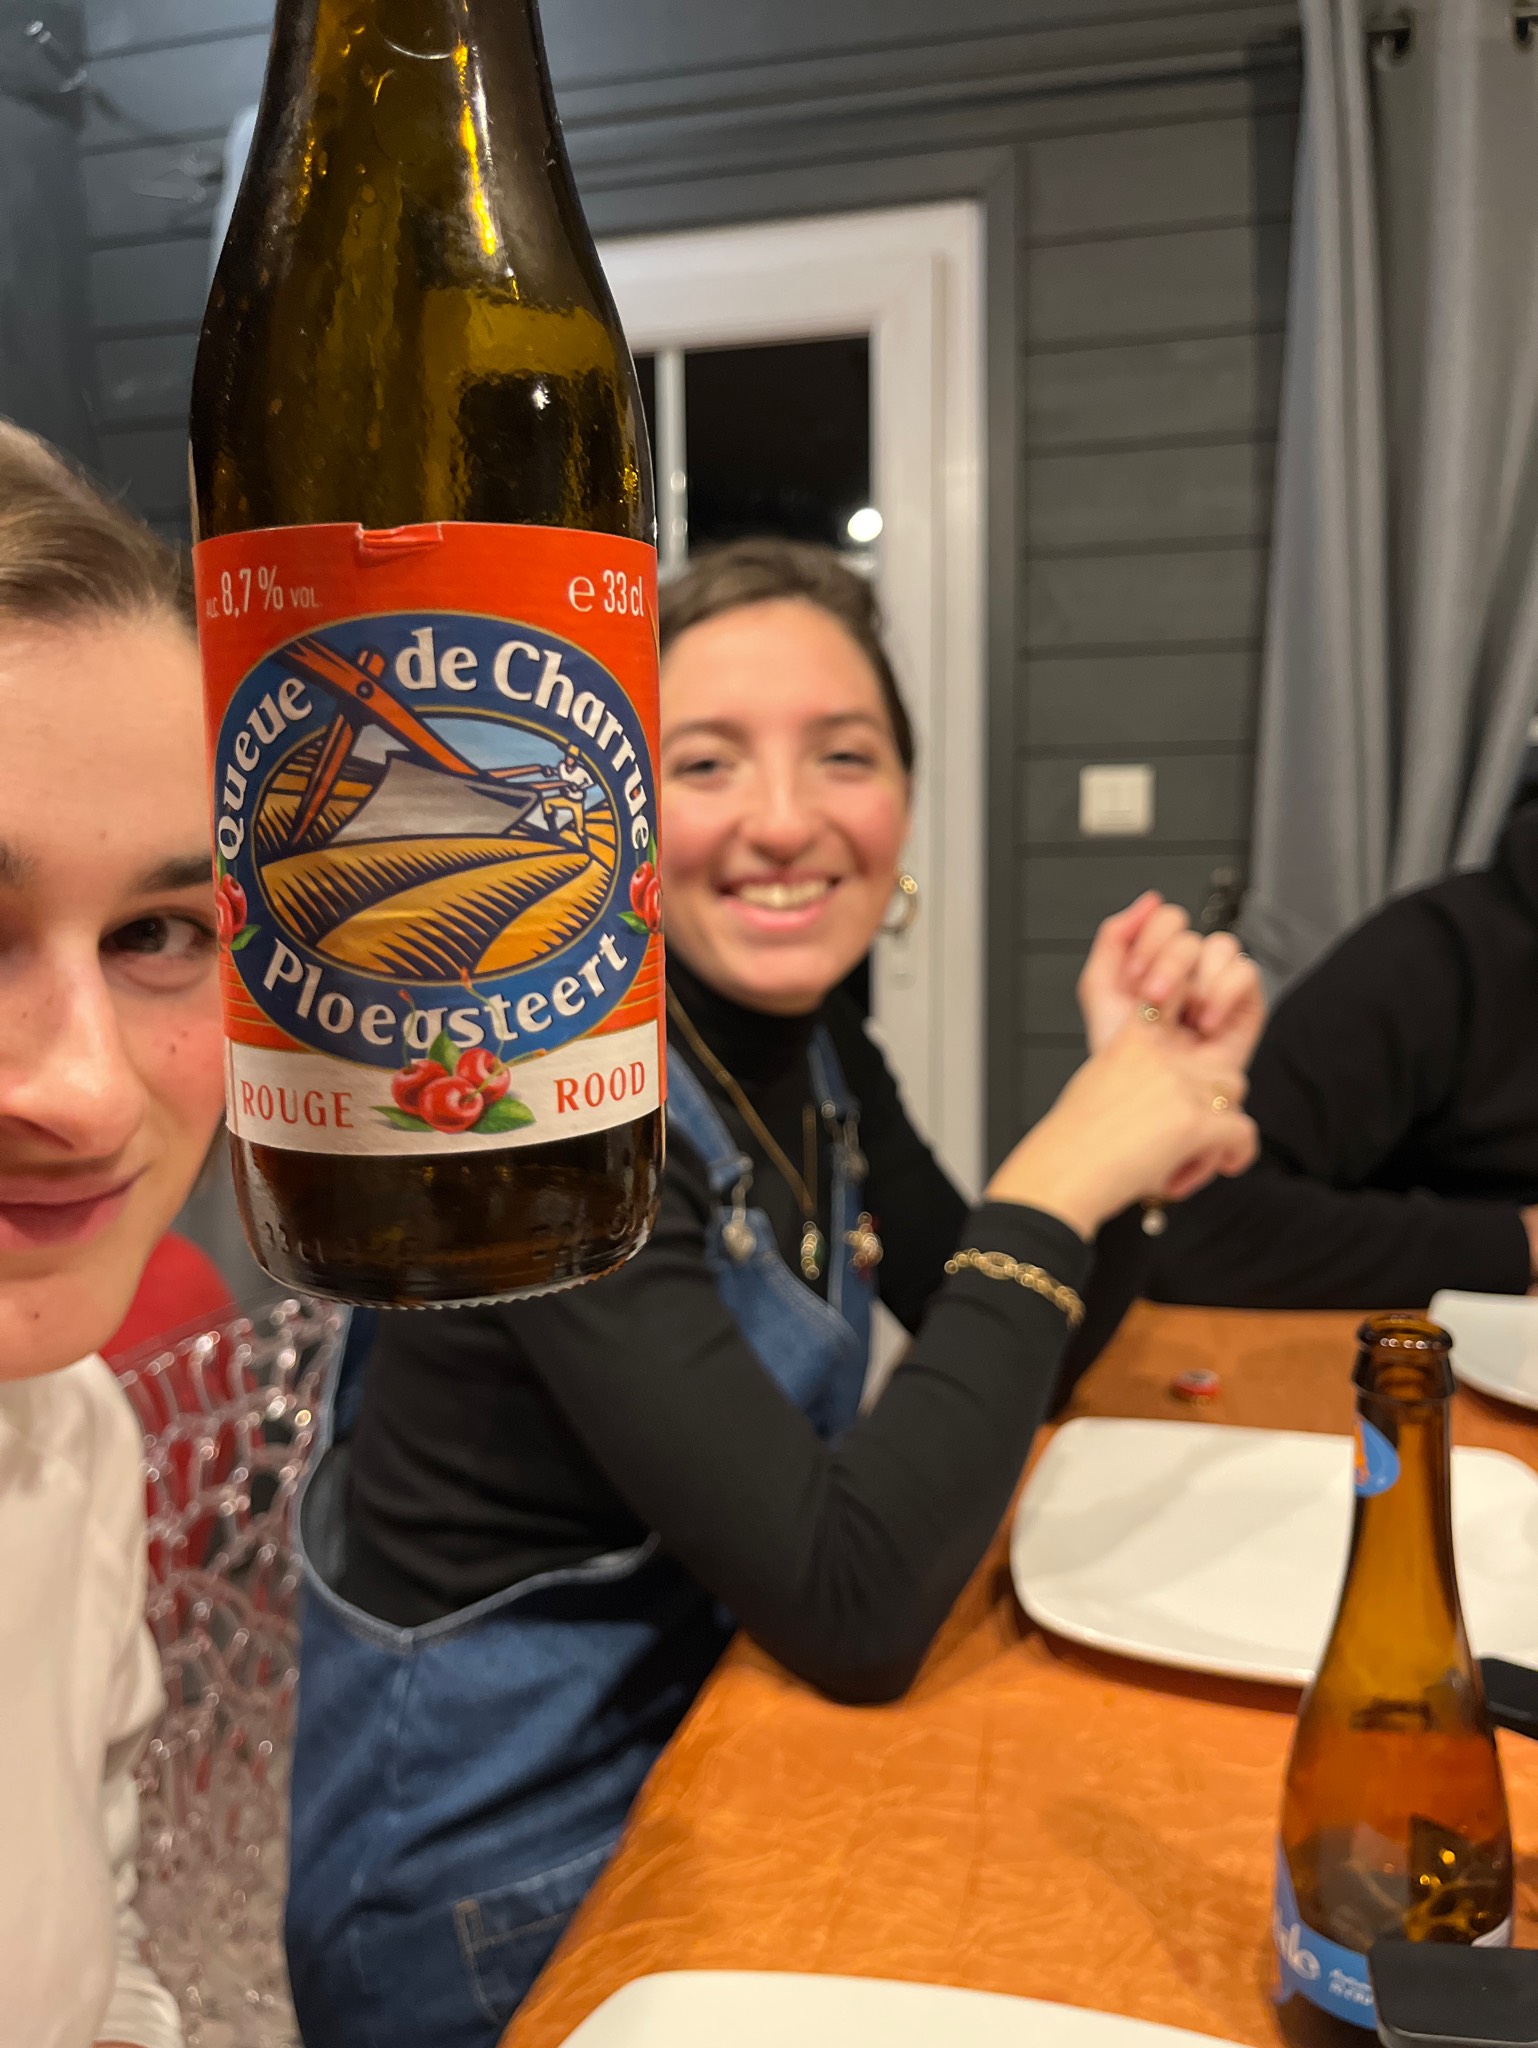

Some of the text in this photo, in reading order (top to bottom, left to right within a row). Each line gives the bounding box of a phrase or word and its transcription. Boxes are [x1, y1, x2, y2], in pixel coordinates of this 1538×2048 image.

[217, 626, 649, 860] Queue de Charrue
[262, 931, 629, 1065] Ploegsteert
[240, 1079, 354, 1129] ROUGE
[553, 1060, 646, 1114] ROOD
